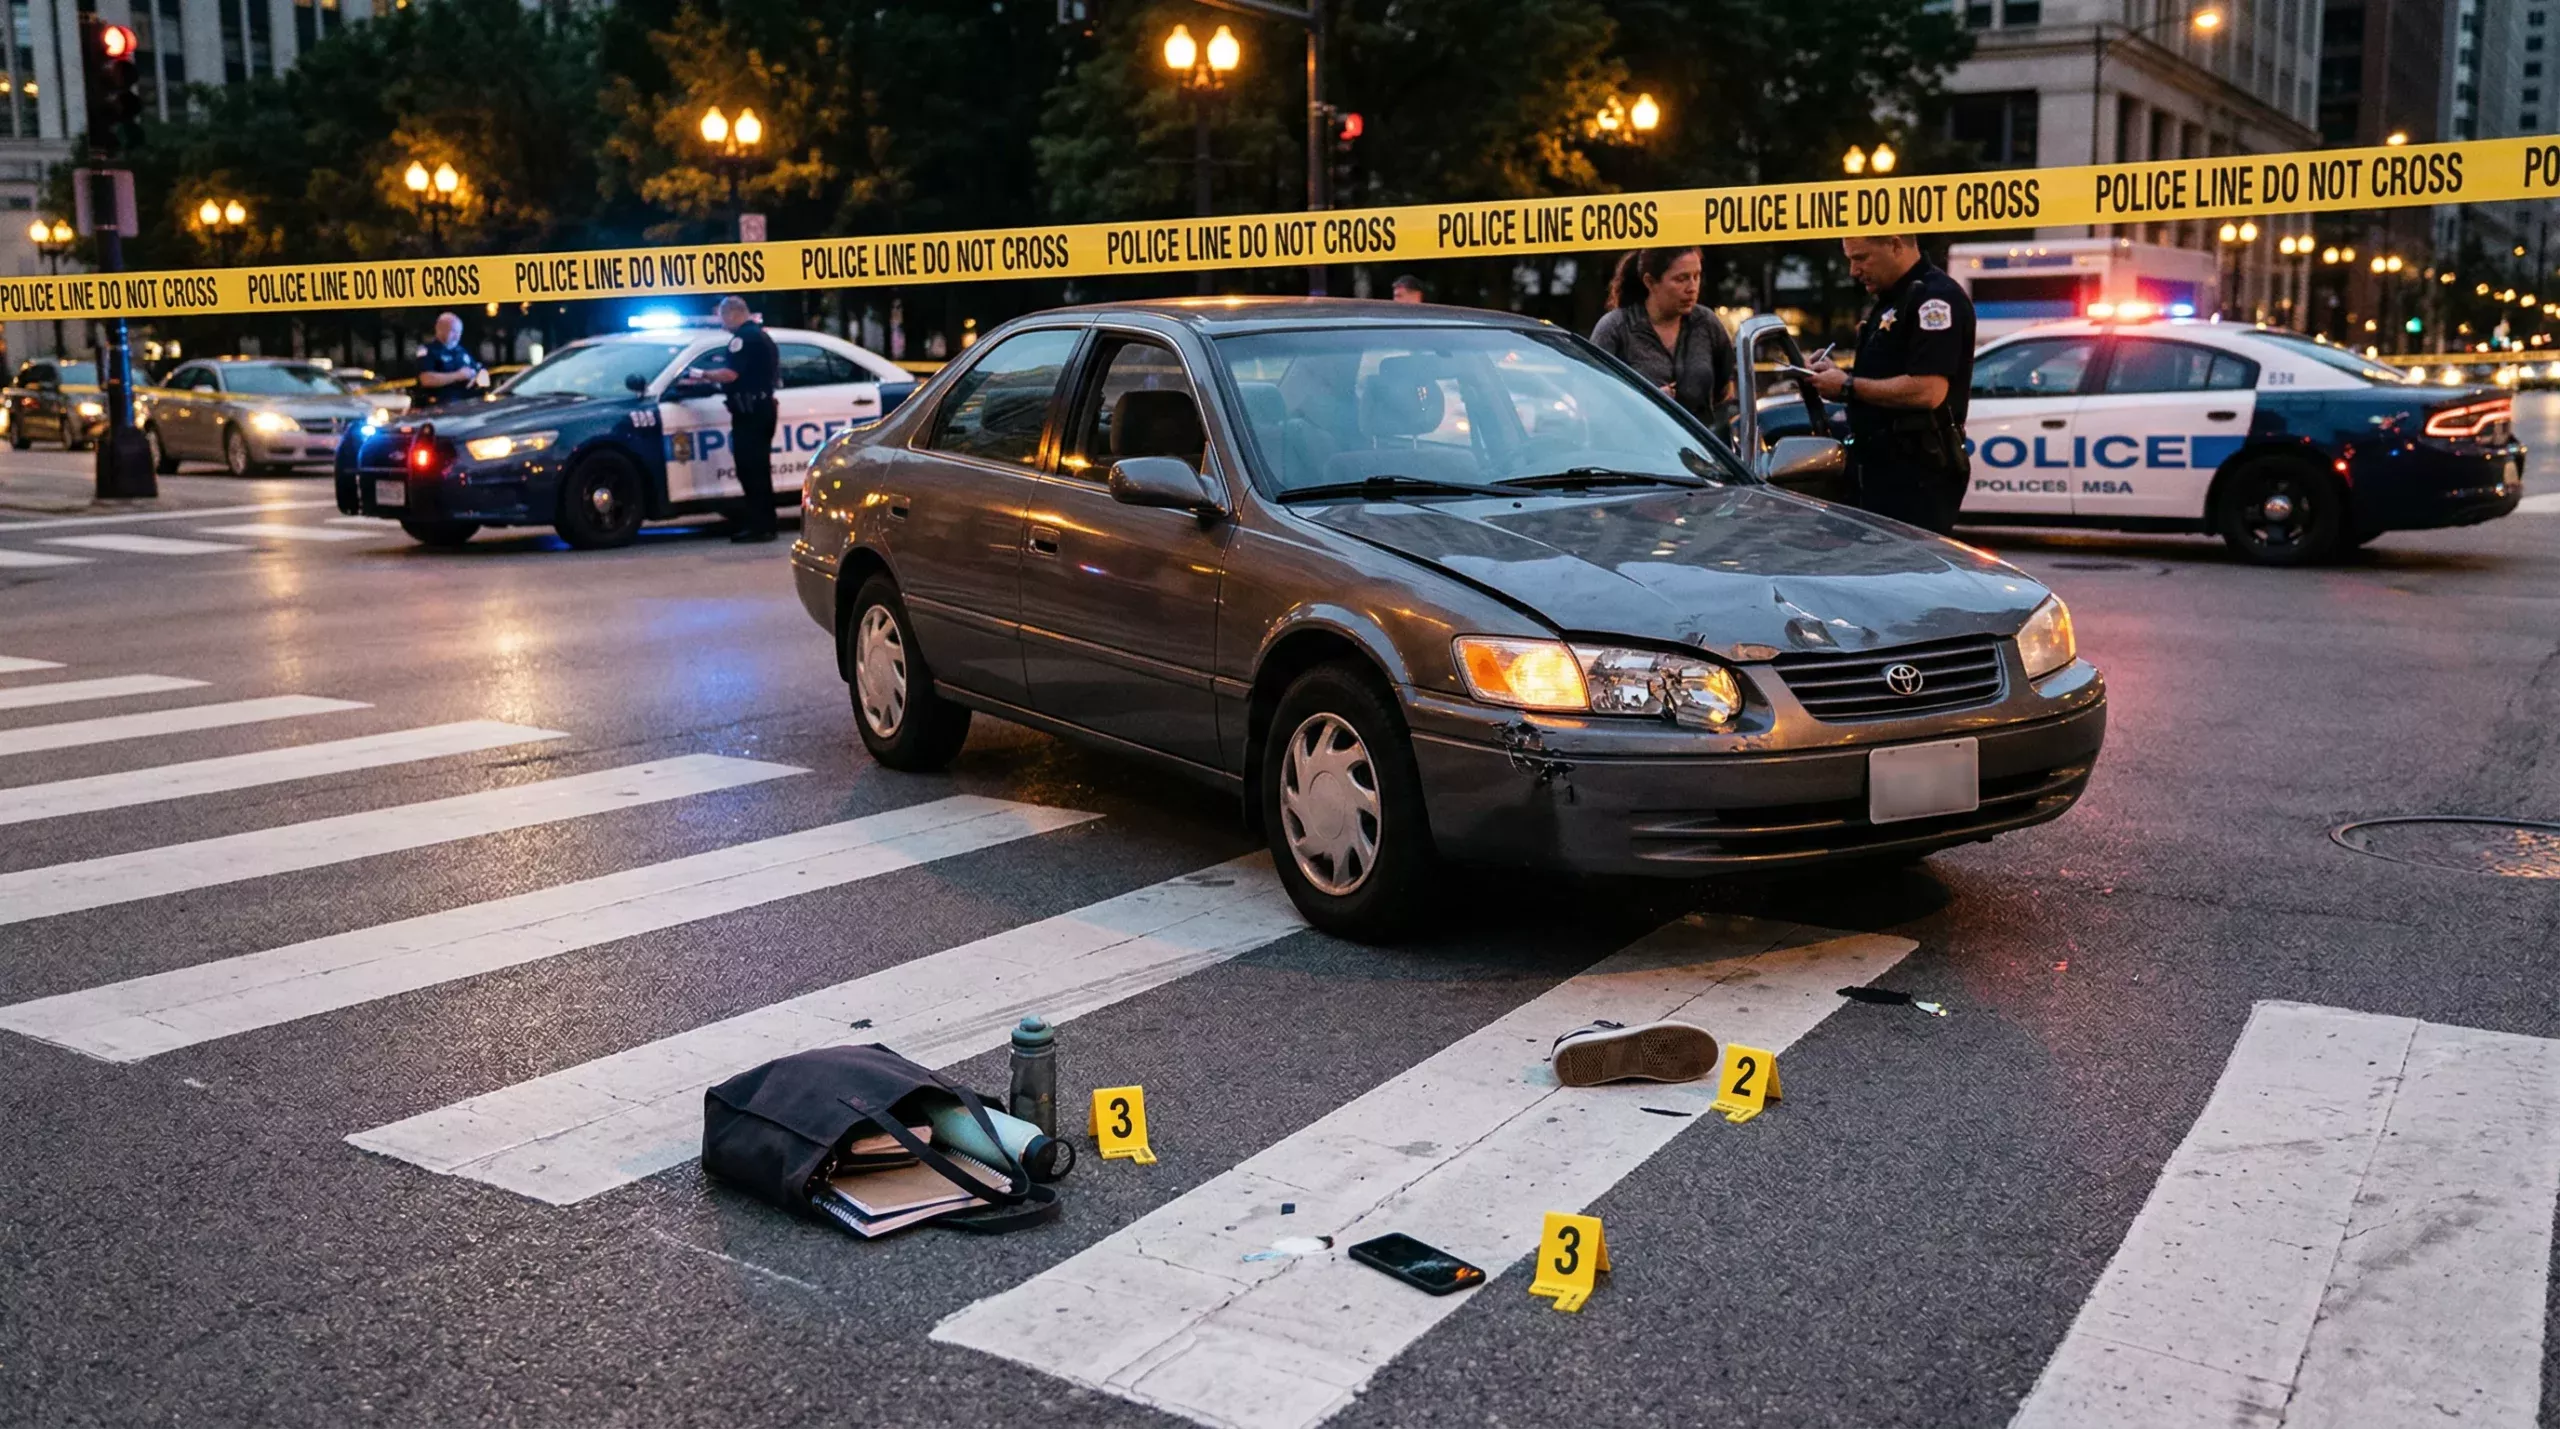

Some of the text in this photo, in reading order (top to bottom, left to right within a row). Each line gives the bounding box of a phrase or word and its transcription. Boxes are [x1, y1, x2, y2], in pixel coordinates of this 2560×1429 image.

[2096, 152, 2462, 213] POLICE LINE DO NOT CROSS
[1439, 201, 1658, 248] POLICE LINE CROSS
[1706, 179, 2039, 234] POLICE LINE DO NOT CROSS
[802, 234, 1068, 280] POLICE LINE DO NOT CROSS
[1108, 217, 1395, 264] POLICE LINE DO NOT CROSS
[248, 264, 479, 304] POLICE LINE DO NOT CROSS
[516, 250, 764, 293] POLICE LINE DO NOT CROSS
[1, 277, 217, 313] POLICE LINE DO NOT CROSS
[698, 421, 846, 461] PIC
[1966, 434, 2186, 469] OLICE
[1974, 479, 2068, 493] POLICES
[1731, 1056, 1756, 1097] 2
[1110, 1097, 1132, 1138] 3
[1554, 1225, 1580, 1275] 3
